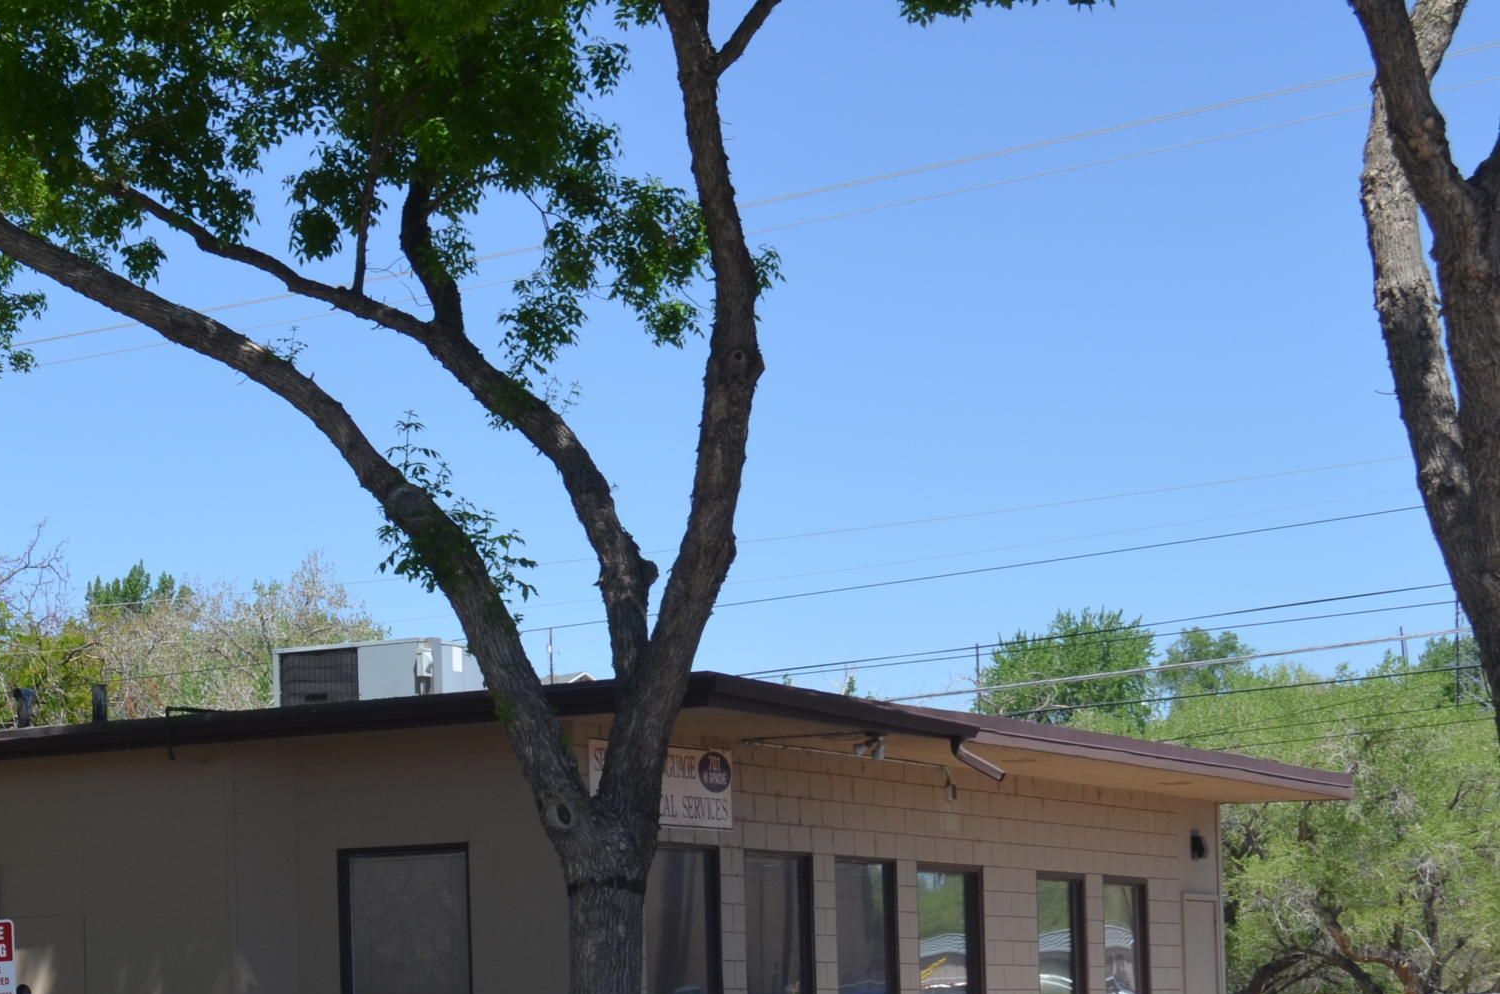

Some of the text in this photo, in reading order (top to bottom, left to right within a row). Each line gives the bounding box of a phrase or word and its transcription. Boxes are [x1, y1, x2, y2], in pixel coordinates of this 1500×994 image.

[663, 754, 696, 779] GUAGE
[708, 755, 721, 771] 701
[682, 796, 728, 821] SERVICES
